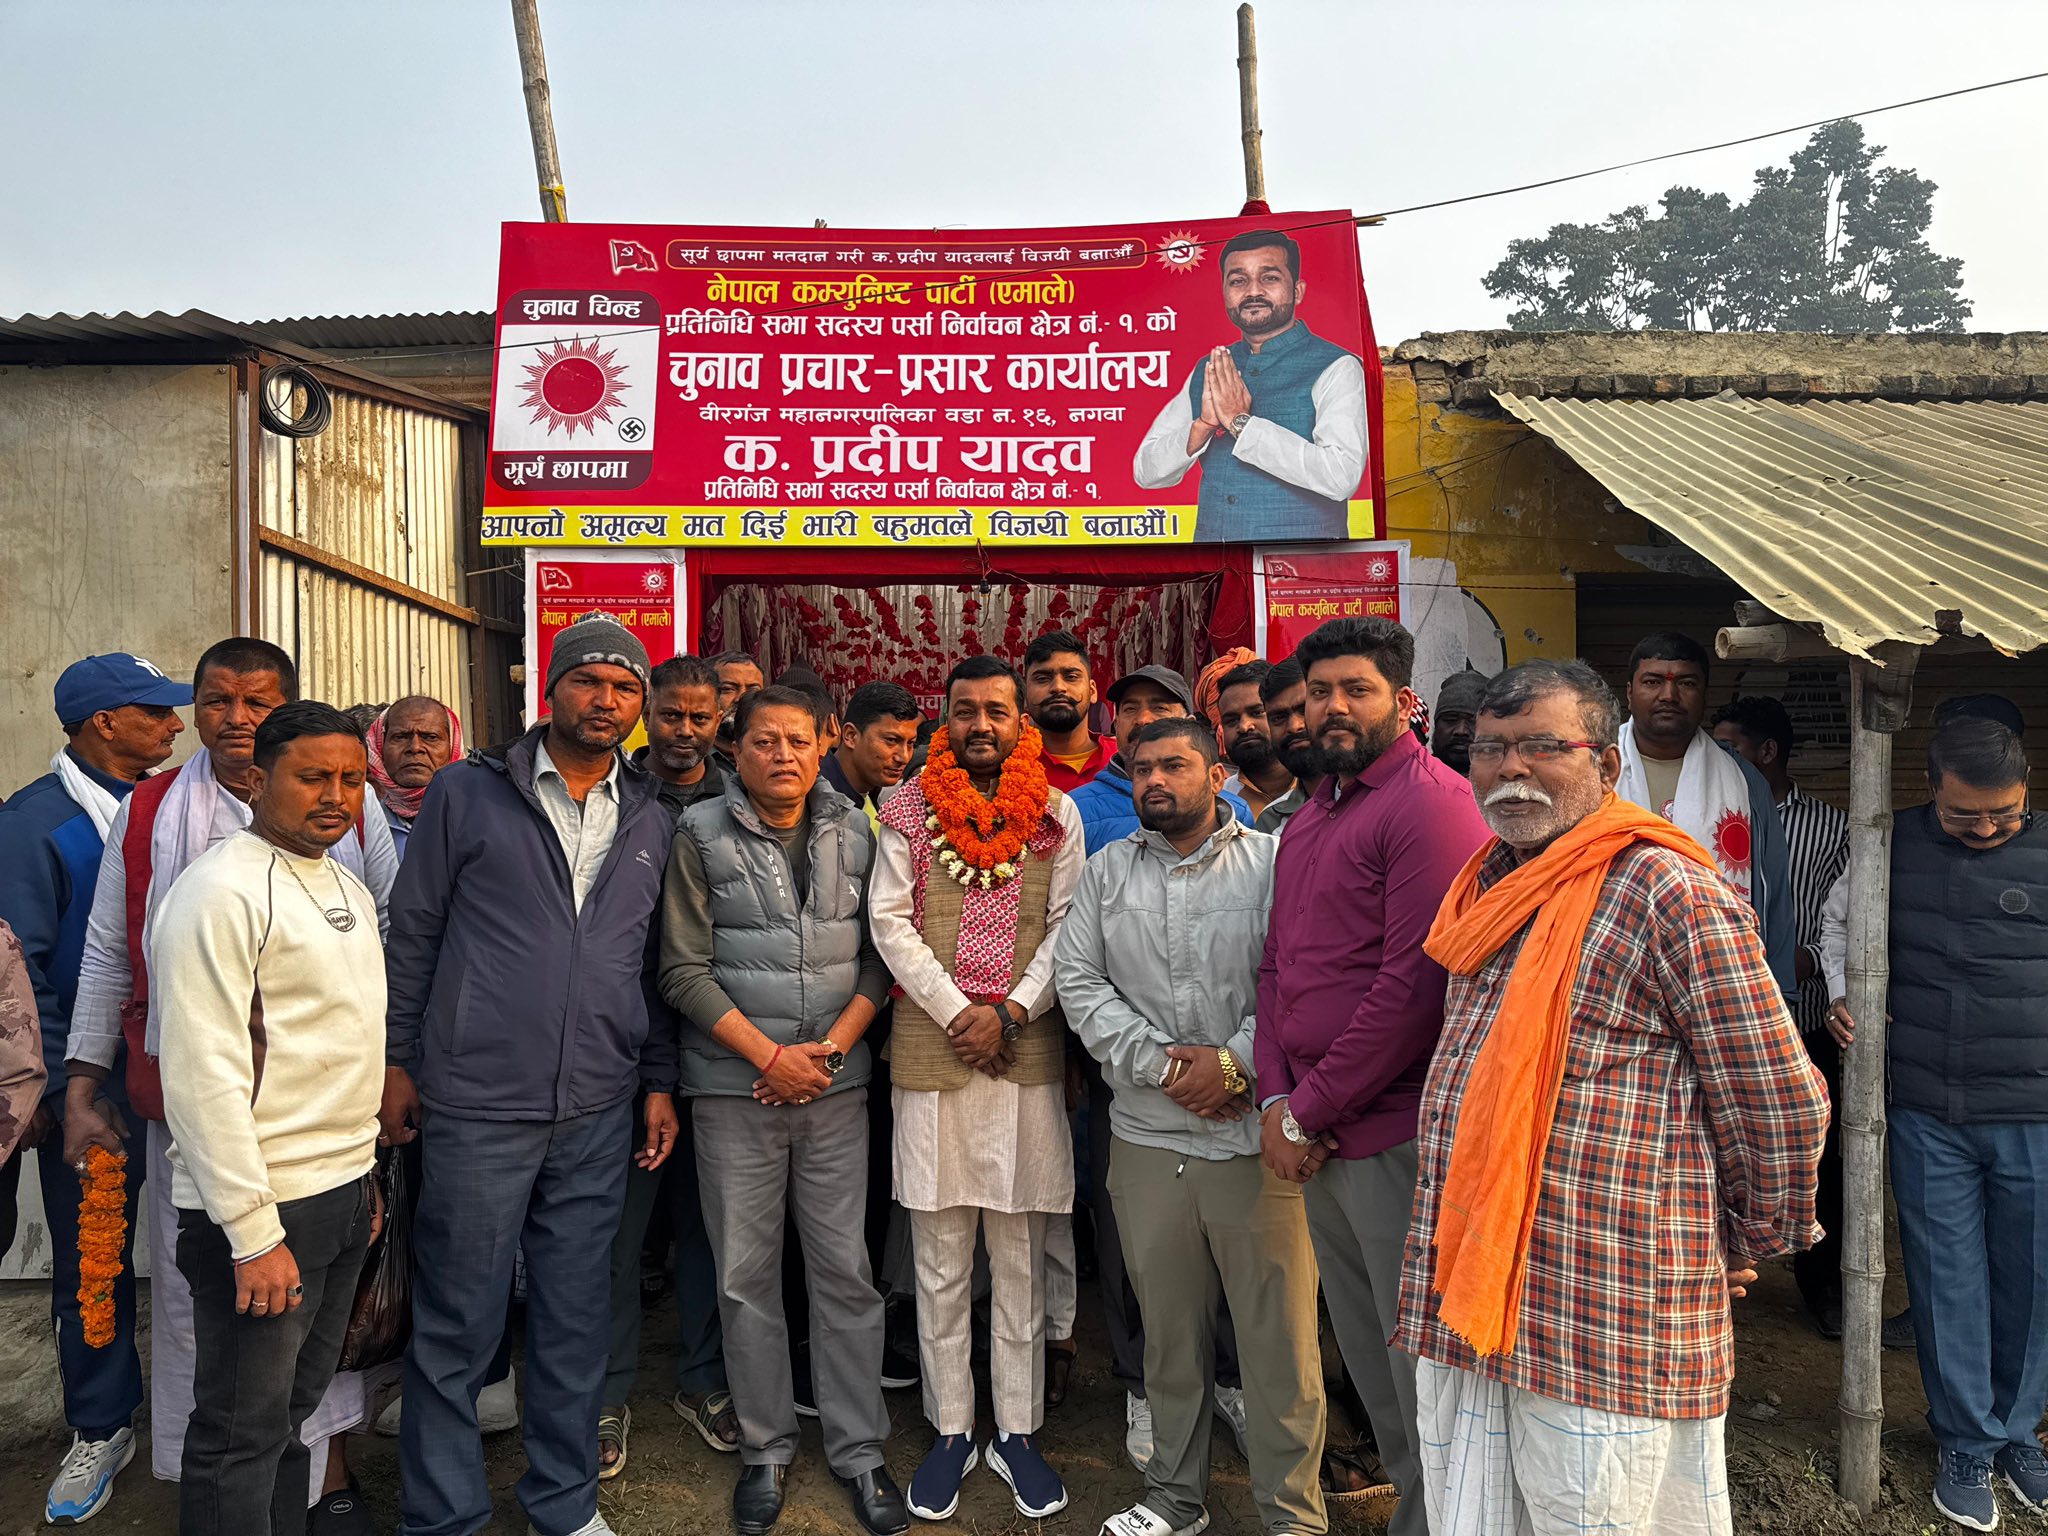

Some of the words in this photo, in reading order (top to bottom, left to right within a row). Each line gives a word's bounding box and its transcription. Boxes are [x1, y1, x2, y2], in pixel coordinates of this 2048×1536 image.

[680, 246, 710, 265] सूर्य
[716, 250, 766, 263] छापमा
[773, 250, 829, 263] मतदान
[836, 248, 865, 264] गरी
[872, 251, 893, 263] क.
[897, 248, 938, 265] प्रदीप
[944, 248, 1015, 265] यादवलाई
[1021, 247, 1071, 262] विजयी
[706, 272, 781, 305] नेपाल
[792, 273, 913, 312] कम्युनिष्ट
[925, 274, 977, 305] पार्टी
[989, 273, 1076, 305] (एमाले)
[522, 299, 580, 321] चुनाव
[588, 294, 643, 319] चिन्ह
[665, 307, 756, 337] प्रतिनिधि
[761, 315, 808, 337] सभा
[815, 315, 885, 337] सदस्य
[890, 311, 935, 338] पर्सा
[941, 309, 1023, 336] निर्वाचन
[1030, 309, 1072, 338] क्षेत्र
[1146, 306, 1178, 332] को
[668, 352, 764, 402] चुनाव
[1006, 341, 1171, 392] कार्यालय
[699, 402, 771, 425] वीरगंज
[779, 402, 937, 426] महानगरपालिका
[944, 407, 985, 424] वडा
[1067, 406, 1127, 423] नगवा
[723, 435, 790, 473] क.
[810, 424, 944, 480] प्रदीप
[959, 436, 1096, 478] यादव
[504, 455, 546, 486] सूर्य
[551, 460, 630, 480] छापमा
[704, 475, 780, 501] प्रतिनिधि
[785, 481, 825, 501] सभा
[830, 481, 889, 501] सदस्य
[894, 477, 930, 501] पर्सा
[935, 476, 1005, 500] निर्वाचन
[1011, 477, 1047, 502] क्षेत्र
[481, 508, 566, 539] आफ्नो
[580, 513, 668, 543] अमूल्य
[682, 514, 726, 538] मत
[740, 509, 788, 541] दिई
[802, 509, 859, 538] भारी
[871, 509, 973, 543] बहुमतले
[988, 509, 1069, 538] विजयी
[541, 608, 567, 626] नेपाल
[641, 609, 672, 626] (एमाले)
[1269, 600, 1295, 617] नेपाल
[1343, 598, 1362, 616] पार्टी
[1366, 596, 1397, 615] (एमाले)
[1128, 1509, 1154, 1531] SMILE
